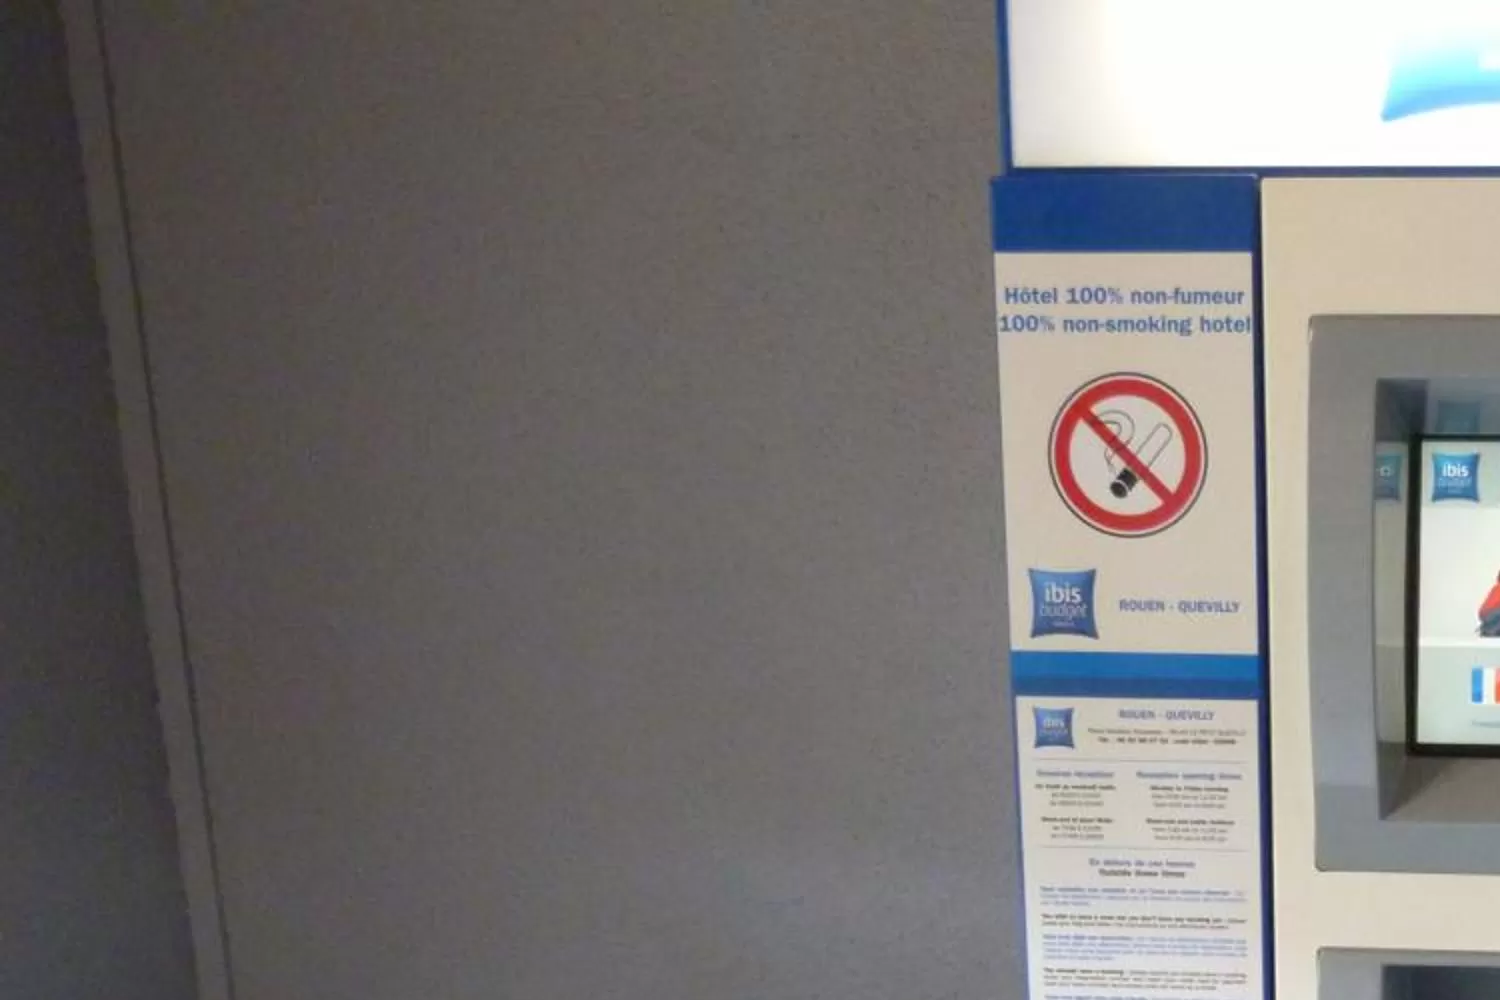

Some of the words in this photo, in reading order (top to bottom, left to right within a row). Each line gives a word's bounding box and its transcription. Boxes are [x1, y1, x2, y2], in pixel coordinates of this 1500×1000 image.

[1004, 287, 1058, 305] Hôtel
[1066, 287, 1123, 305] 100%
[1131, 288, 1245, 305] non-fumeur
[1000, 315, 1055, 332] 100%
[1063, 315, 1192, 336] non-smoking
[1200, 316, 1252, 333] hotel
[1442, 463, 1470, 477] ibis
[1045, 581, 1083, 602] ibis
[1119, 599, 1165, 613] ROUEN
[1178, 600, 1240, 614] QUEVILLY
